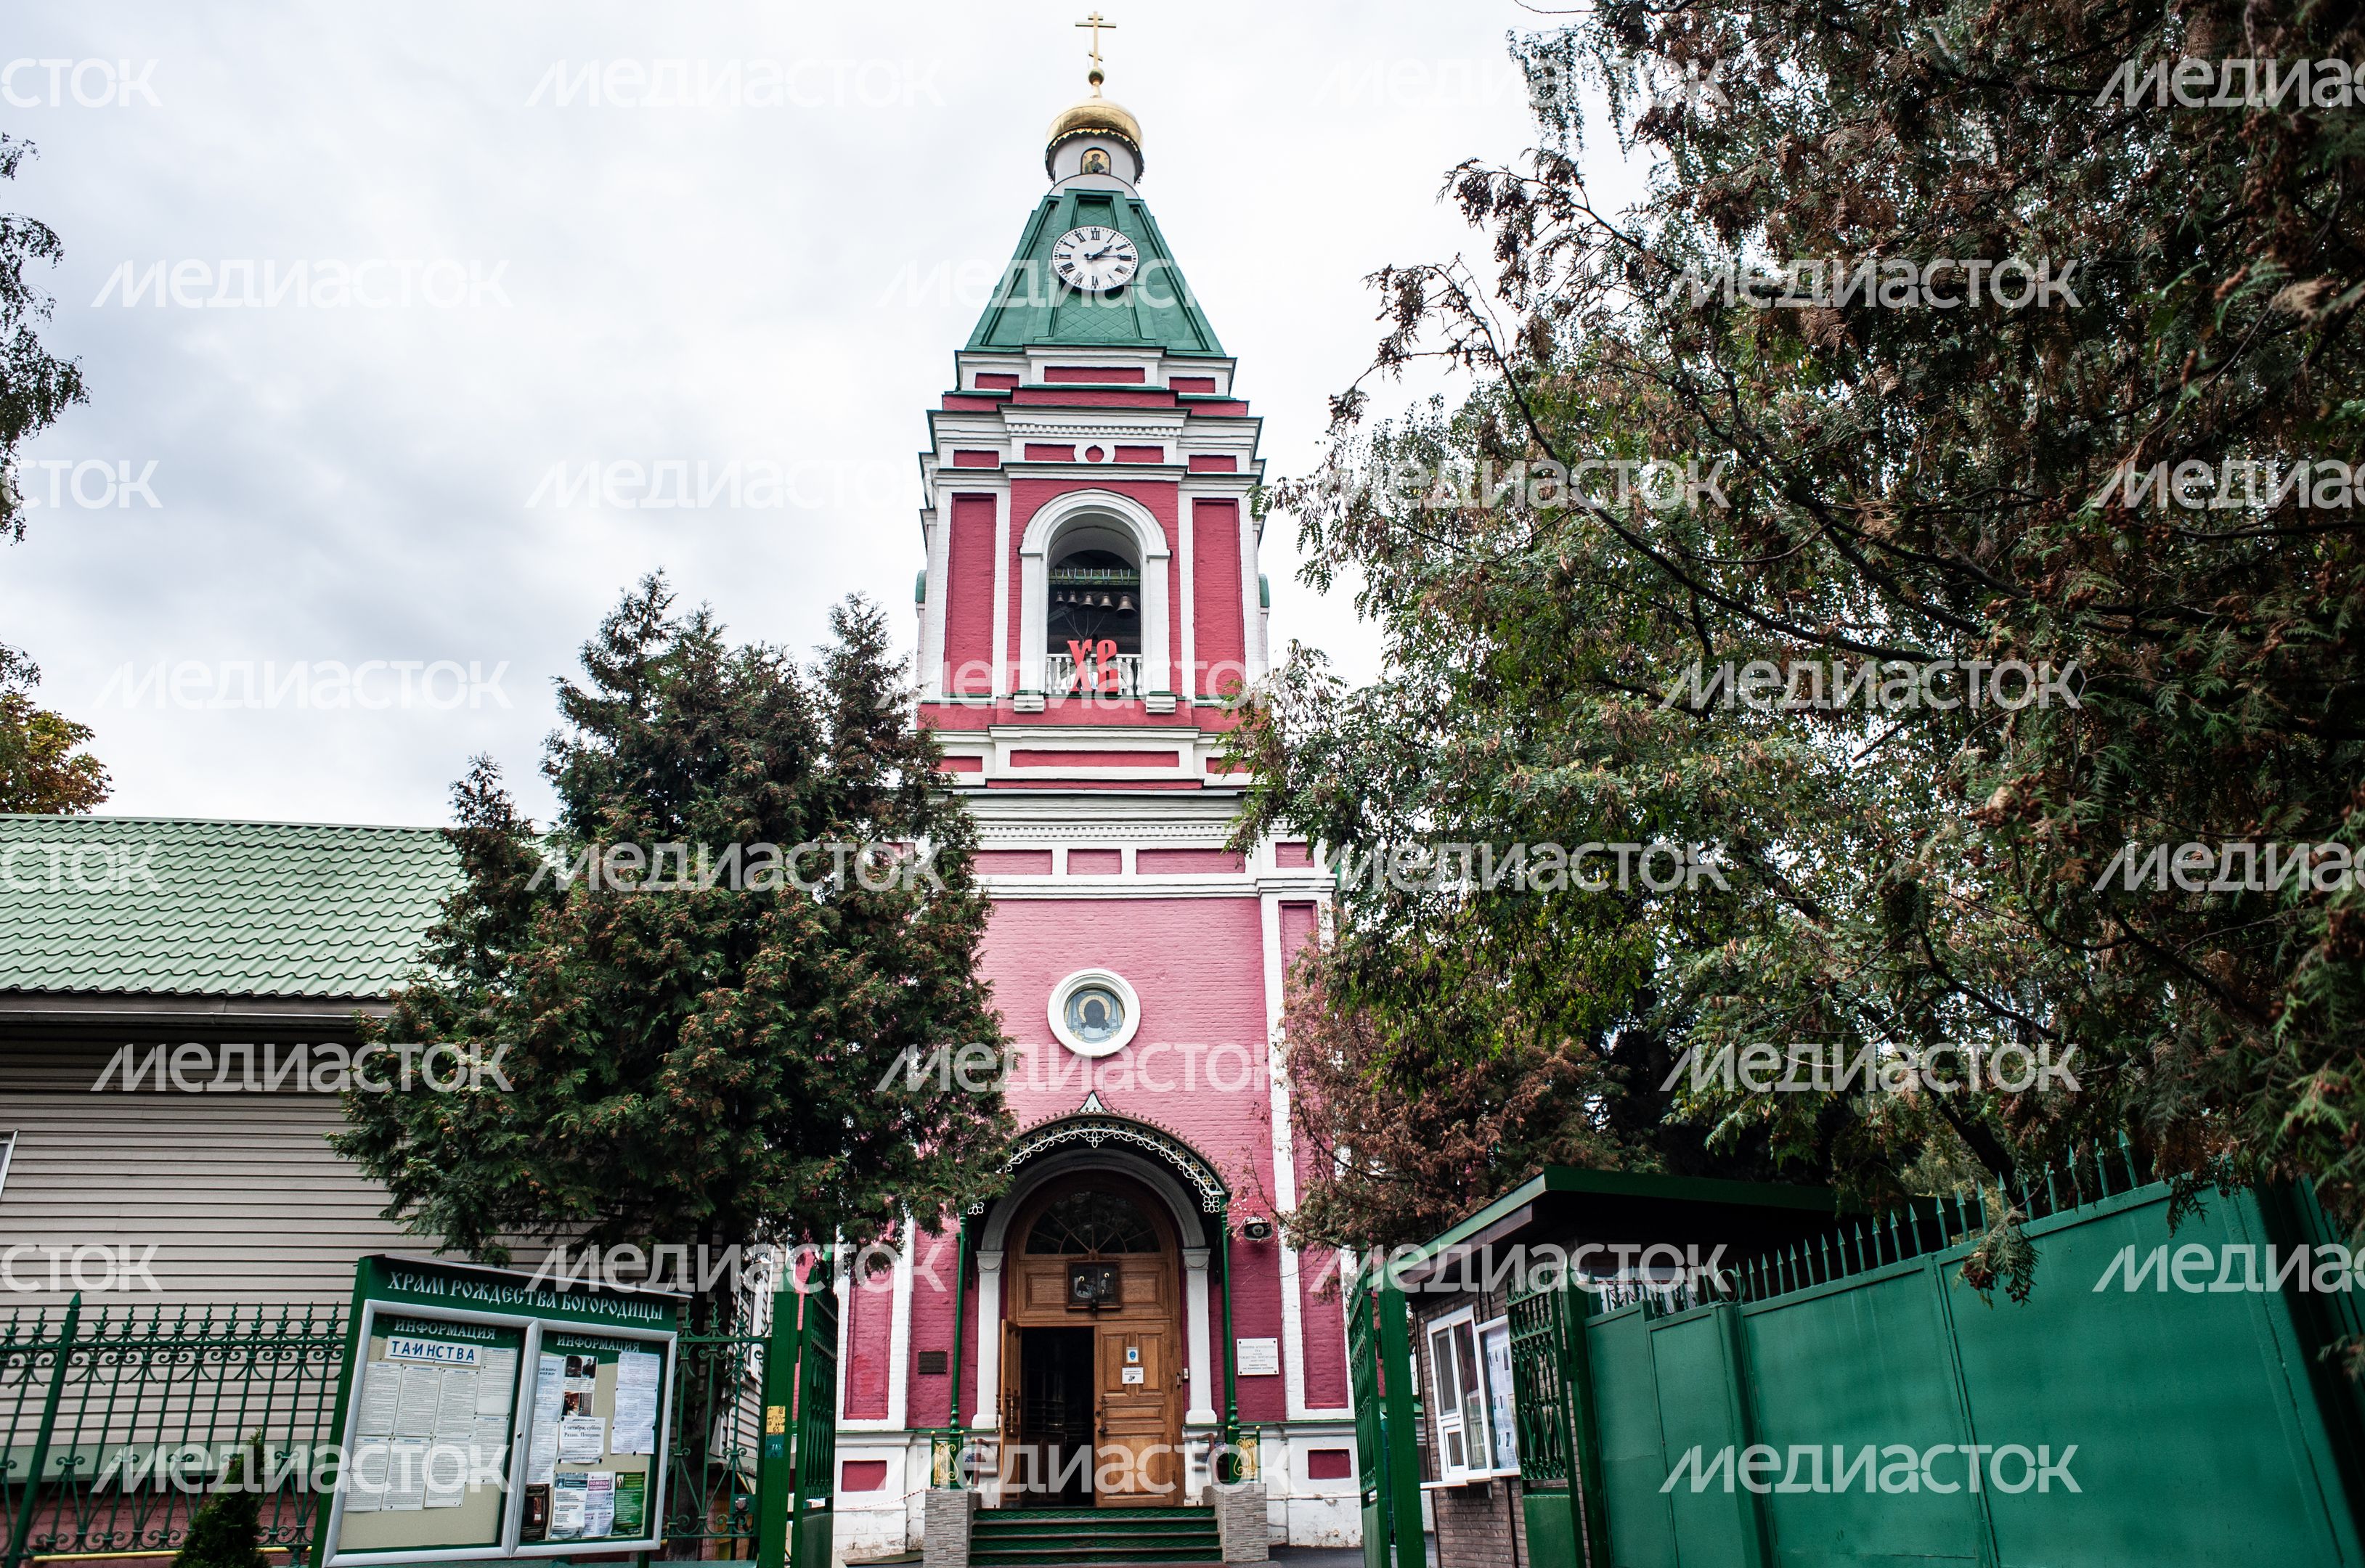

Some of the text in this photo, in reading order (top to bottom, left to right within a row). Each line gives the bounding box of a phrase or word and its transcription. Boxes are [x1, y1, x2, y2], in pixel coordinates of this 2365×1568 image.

[388, 1272, 664, 1321] ХРАМ РОЖДЕСТВА БОГОРОДИЦЫ
[394, 1319, 497, 1340] ИНФОРМАЦИЯ
[391, 1341, 475, 1361] ТАИНСТВА
[556, 1334, 640, 1352] ИНФОРМАЦИЯ
